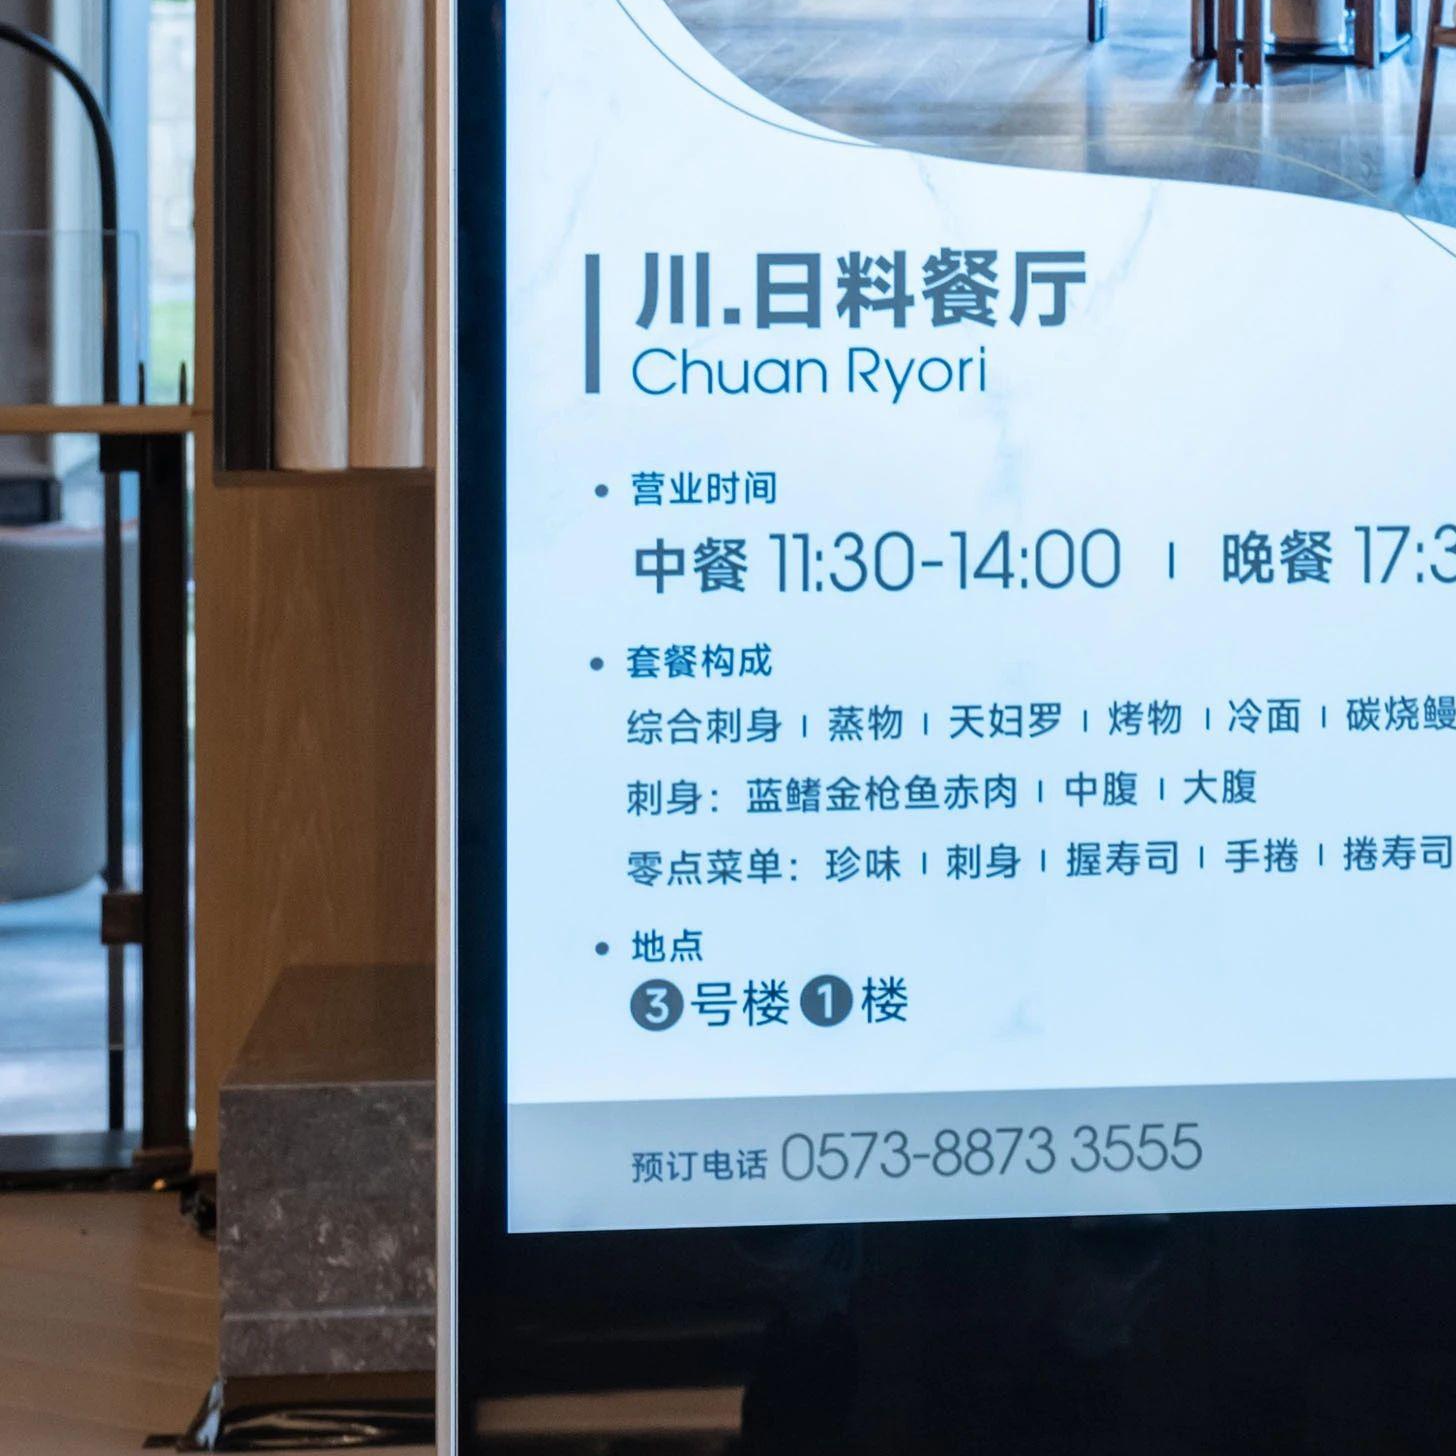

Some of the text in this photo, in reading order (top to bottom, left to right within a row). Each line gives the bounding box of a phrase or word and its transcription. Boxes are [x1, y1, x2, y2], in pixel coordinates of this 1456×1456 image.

[631, 346, 987, 404] Chuan Ryori
[631, 471, 777, 507] 营业时间
[635, 536, 748, 594] 中餐
[768, 527, 1122, 593] 11:30-14:00
[1222, 528, 1333, 586] 晚餐
[626, 642, 773, 680] 套餐构成
[626, 706, 783, 746] 综合刺身
[827, 703, 904, 743] 蒸物
[948, 701, 1063, 740] 天妇罗
[1107, 699, 1182, 737] 烤物
[1227, 696, 1301, 734] 冷面
[1064, 770, 1138, 809] 中腹
[1183, 767, 1258, 805] 大腹
[946, 842, 1022, 881] 刺身
[1065, 838, 1179, 879] 握寿司
[631, 927, 704, 963] 地点
[631, 1122, 1203, 1184] 预订电话 0573-8873 3555
